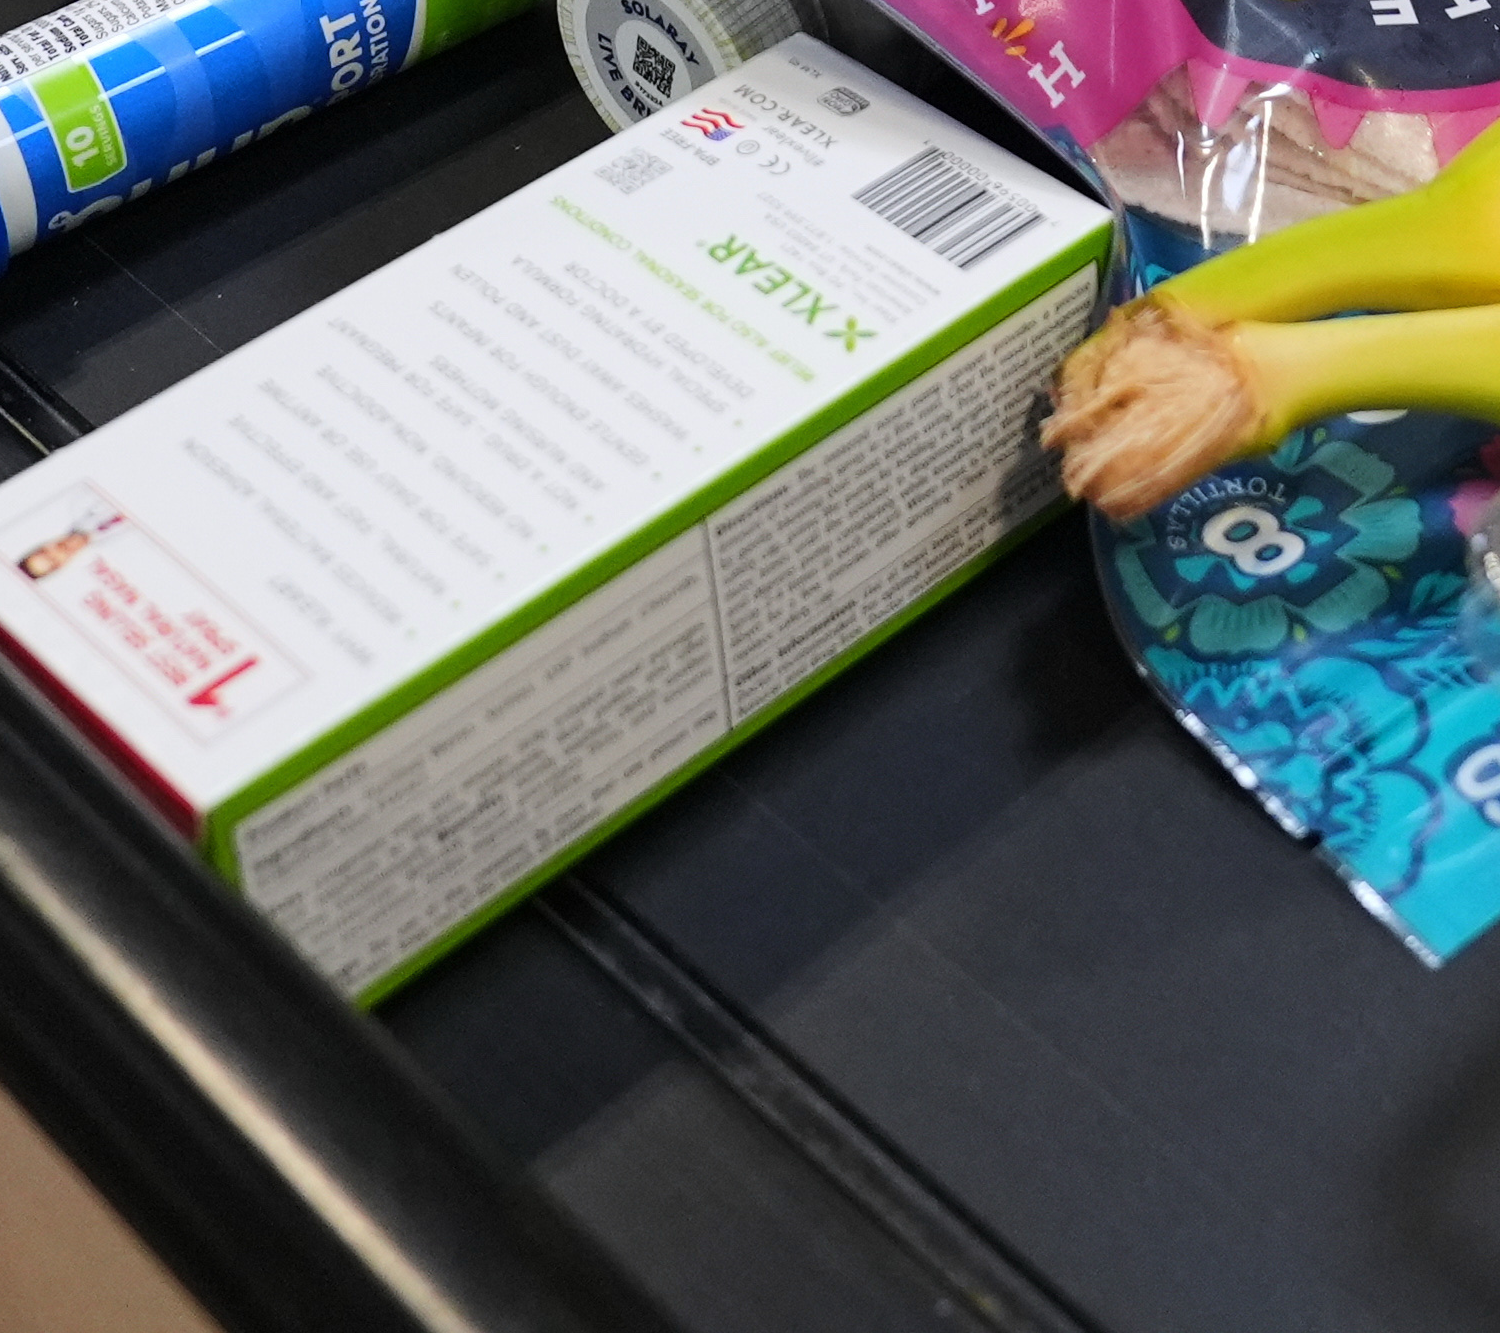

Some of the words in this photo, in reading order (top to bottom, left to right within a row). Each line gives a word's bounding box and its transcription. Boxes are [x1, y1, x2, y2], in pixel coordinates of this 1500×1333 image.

[48, 26, 78, 54] Sodium
[81, 13, 109, 41] Sugars
[110, 0, 141, 27] Calcium
[319, 12, 364, 109] PORT
[65, 124, 96, 168] 10
[732, 82, 840, 152] XLEAR.COM
[706, 234, 840, 325] XLEAR
[1166, 473, 1290, 552] TORTILLAS
[1202, 506, 1309, 577] 8
